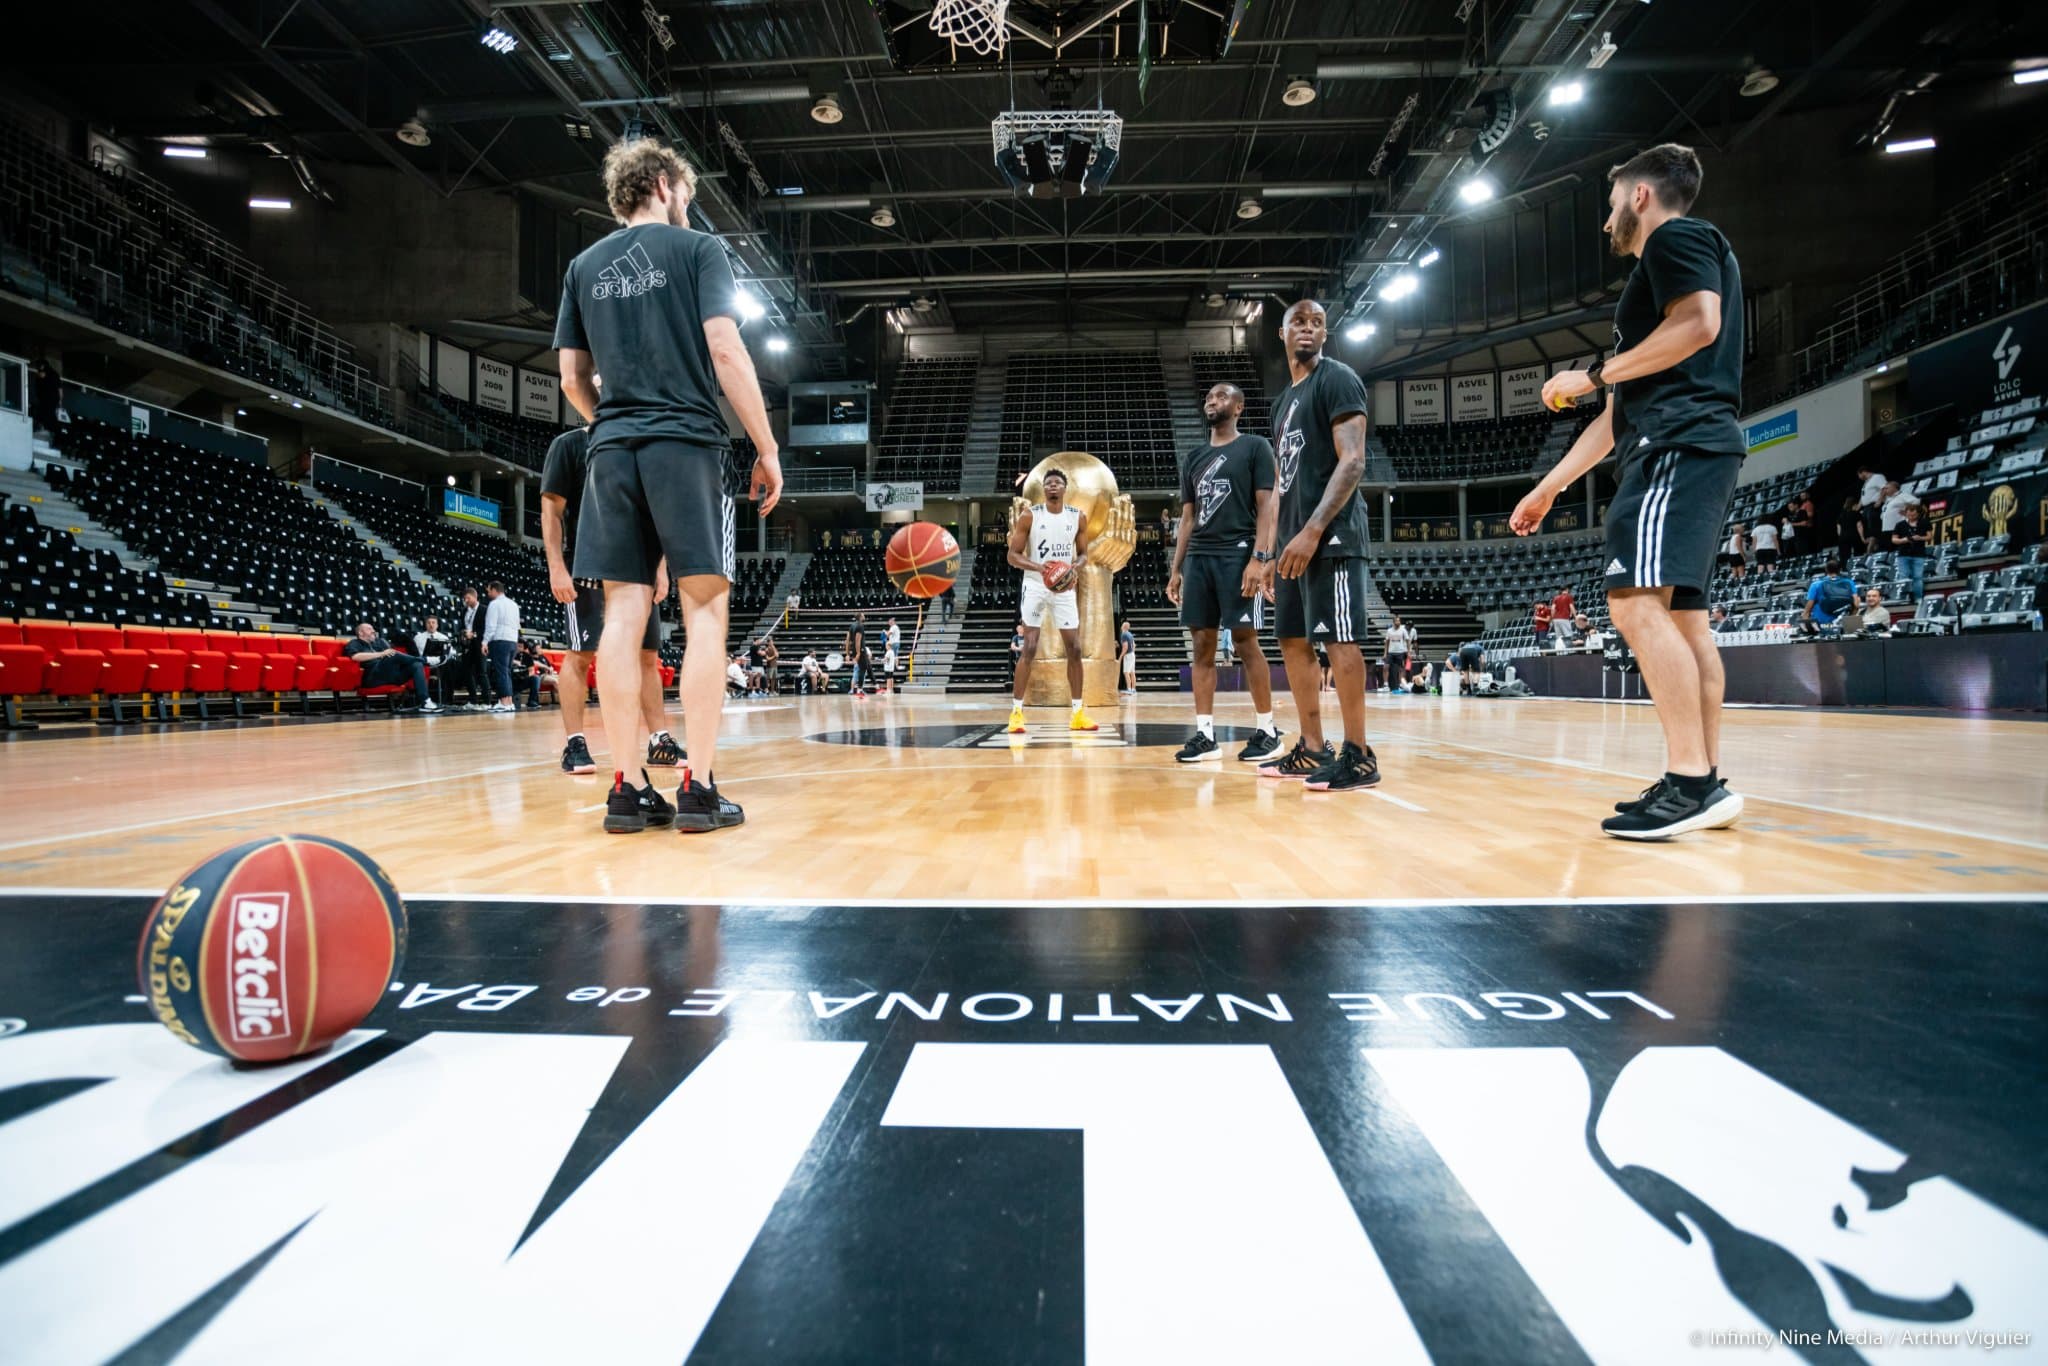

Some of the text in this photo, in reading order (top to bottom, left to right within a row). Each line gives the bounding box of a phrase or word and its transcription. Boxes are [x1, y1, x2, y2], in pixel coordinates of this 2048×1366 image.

[592, 270, 667, 300] adidas
[480, 362, 507, 377] ASVEL
[1508, 371, 1538, 382] ASVEL
[525, 375, 553, 388] ASVEL
[1409, 383, 1438, 392] ASVEL
[1457, 378, 1488, 389] ASVEL
[1993, 378, 2021, 394] LDLC
[233, 900, 283, 1036] Betclic
[566, 985, 652, 1006] de
[668, 988, 1294, 1022] NATIONALE
[1327, 991, 1675, 1021] LIGUE
